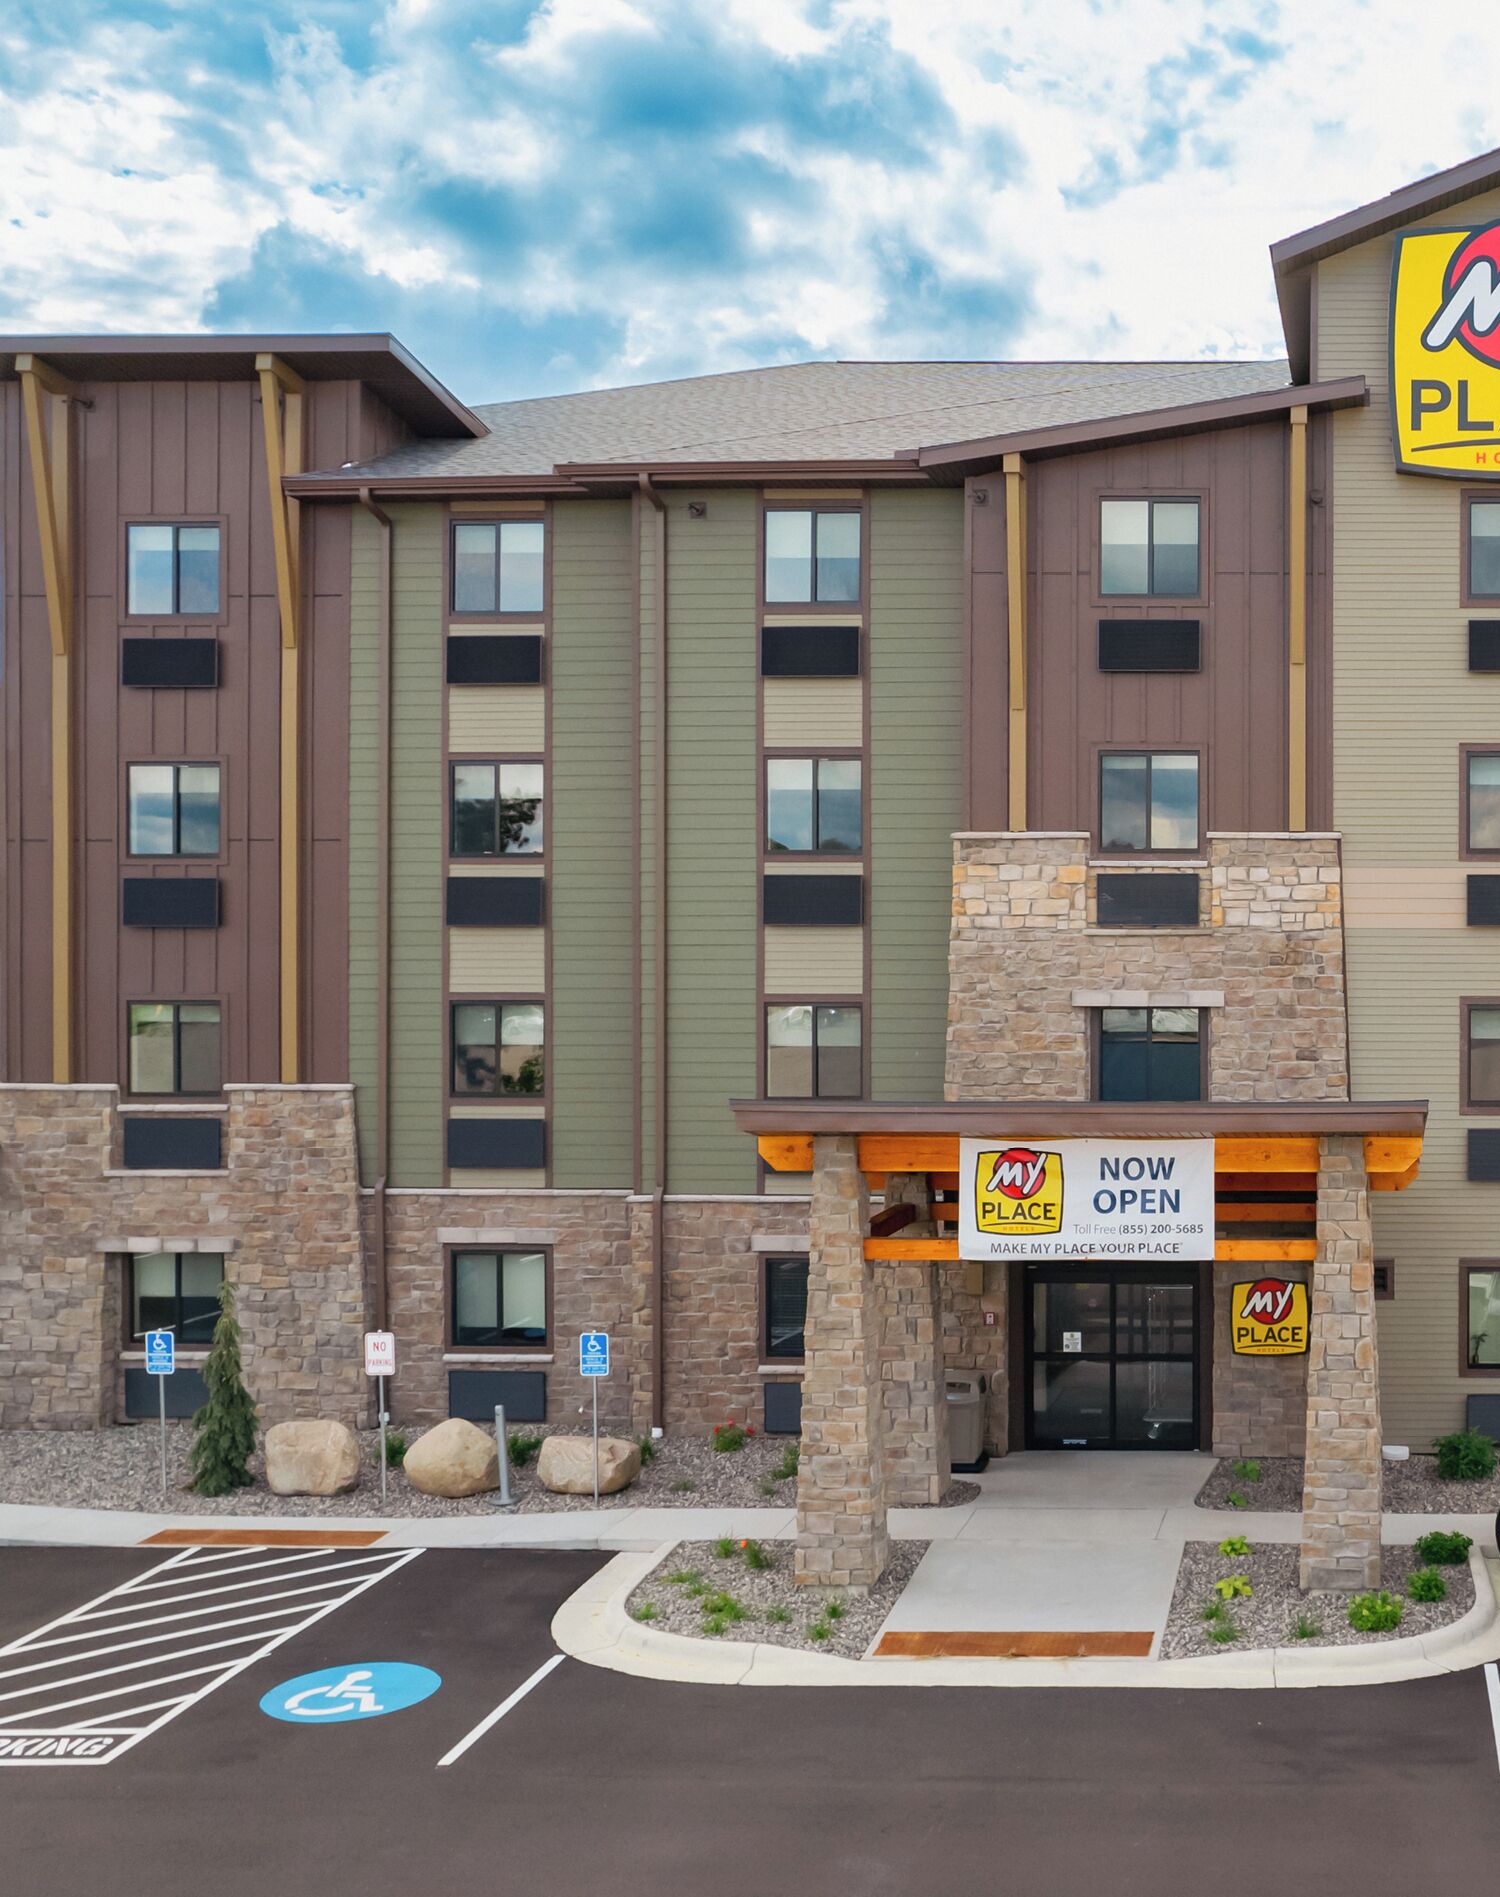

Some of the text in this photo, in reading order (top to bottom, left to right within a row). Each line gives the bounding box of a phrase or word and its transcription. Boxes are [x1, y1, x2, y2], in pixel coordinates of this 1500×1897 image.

[1099, 1157, 1176, 1181] NOW
[1092, 1188, 1181, 1214] OPEN
[981, 1202, 1057, 1221] PLACE
[1073, 1224, 1204, 1235] Toll Free (855) 200-5685
[990, 1242, 1181, 1254] MAKE MY PLACE YOUR PLACE
[1236, 1326, 1303, 1343] PLACE
[372, 1341, 387, 1352] NO
